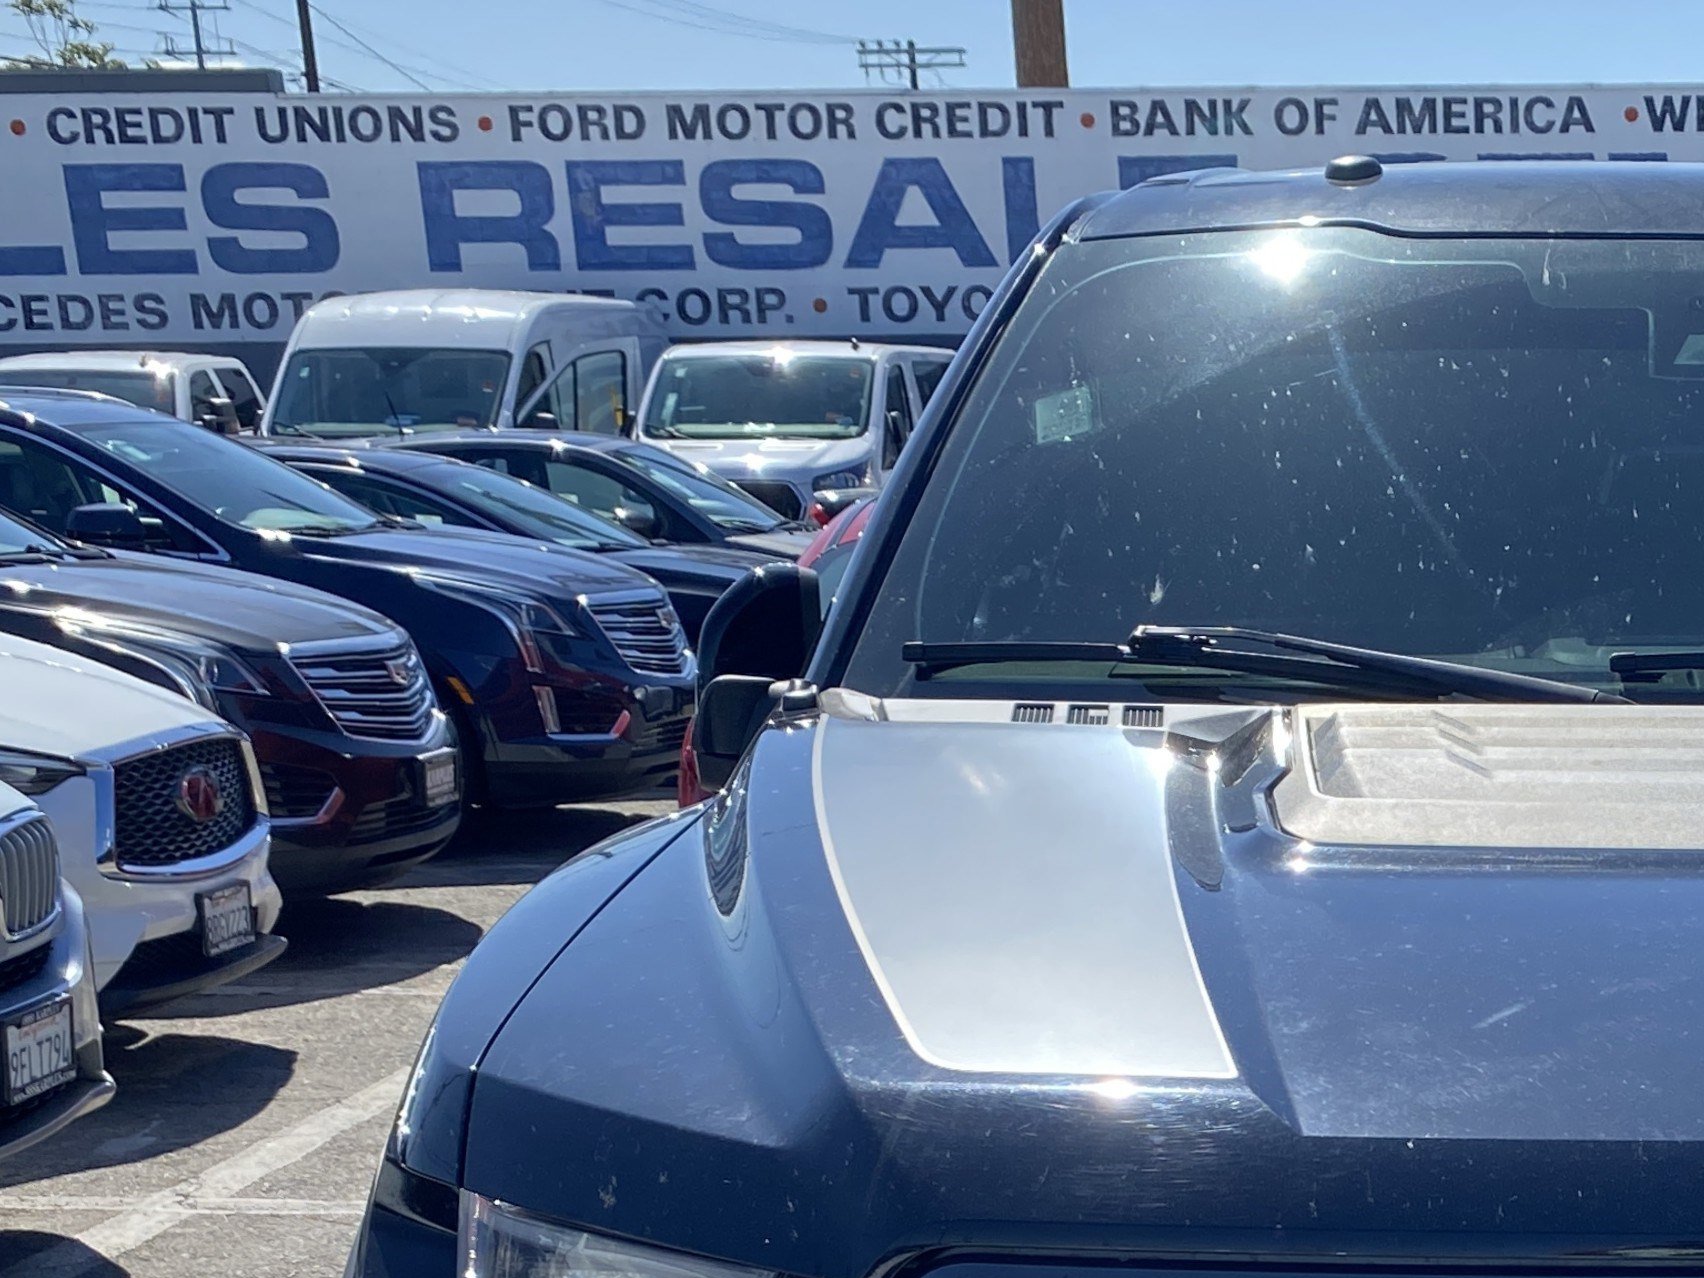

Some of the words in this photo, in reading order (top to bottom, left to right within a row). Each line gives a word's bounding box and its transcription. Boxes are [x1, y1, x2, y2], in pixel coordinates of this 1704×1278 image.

[46, 105, 235, 145] CREDIT
[256, 104, 461, 144] UNIONS
[508, 103, 646, 142] FORD
[667, 102, 857, 141] MOTOR
[875, 100, 1064, 140] CREDIT
[1110, 98, 1254, 137] BANK
[1273, 97, 1338, 136] OF
[1354, 95, 1595, 135] AMERICA
